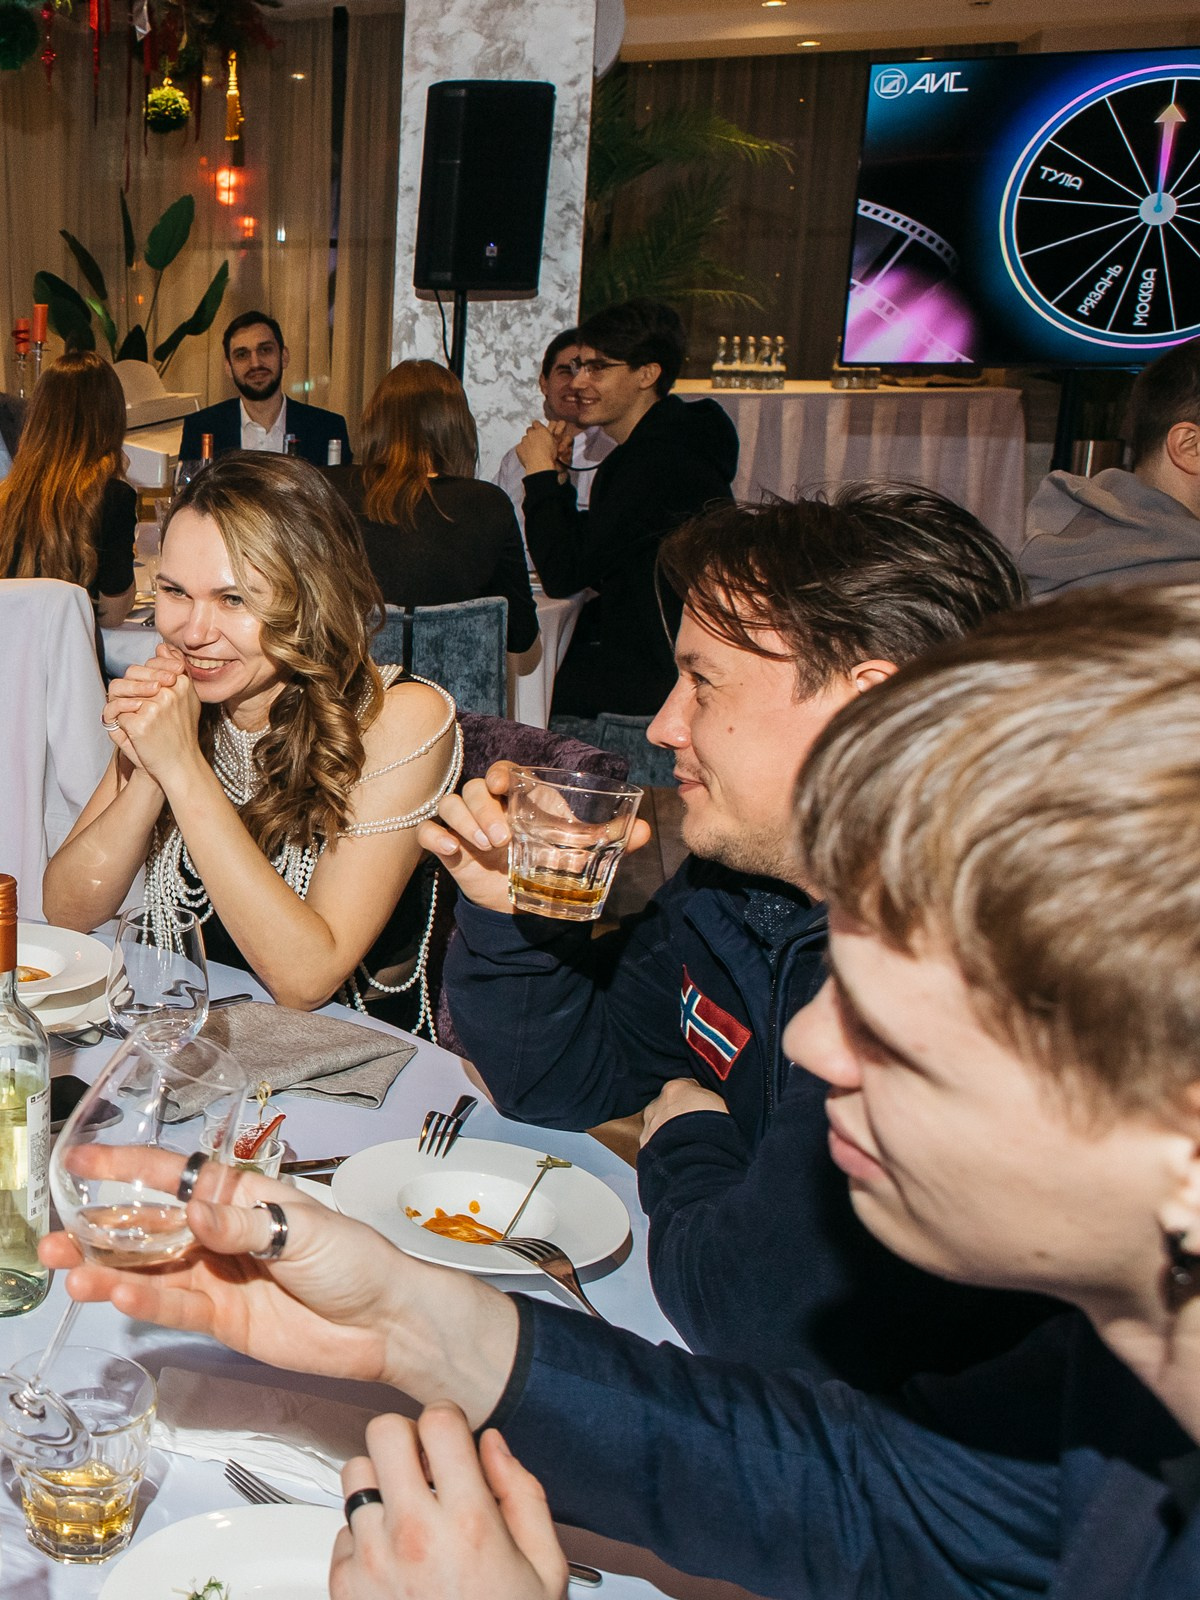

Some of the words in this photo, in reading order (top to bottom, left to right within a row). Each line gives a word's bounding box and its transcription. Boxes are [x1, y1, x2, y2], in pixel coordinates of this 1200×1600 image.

[906, 71, 969, 95] АИС
[1039, 165, 1084, 191] ТУЛА
[1076, 264, 1124, 317] РЯЗАНЬ
[1132, 267, 1158, 327] МОСКВА
